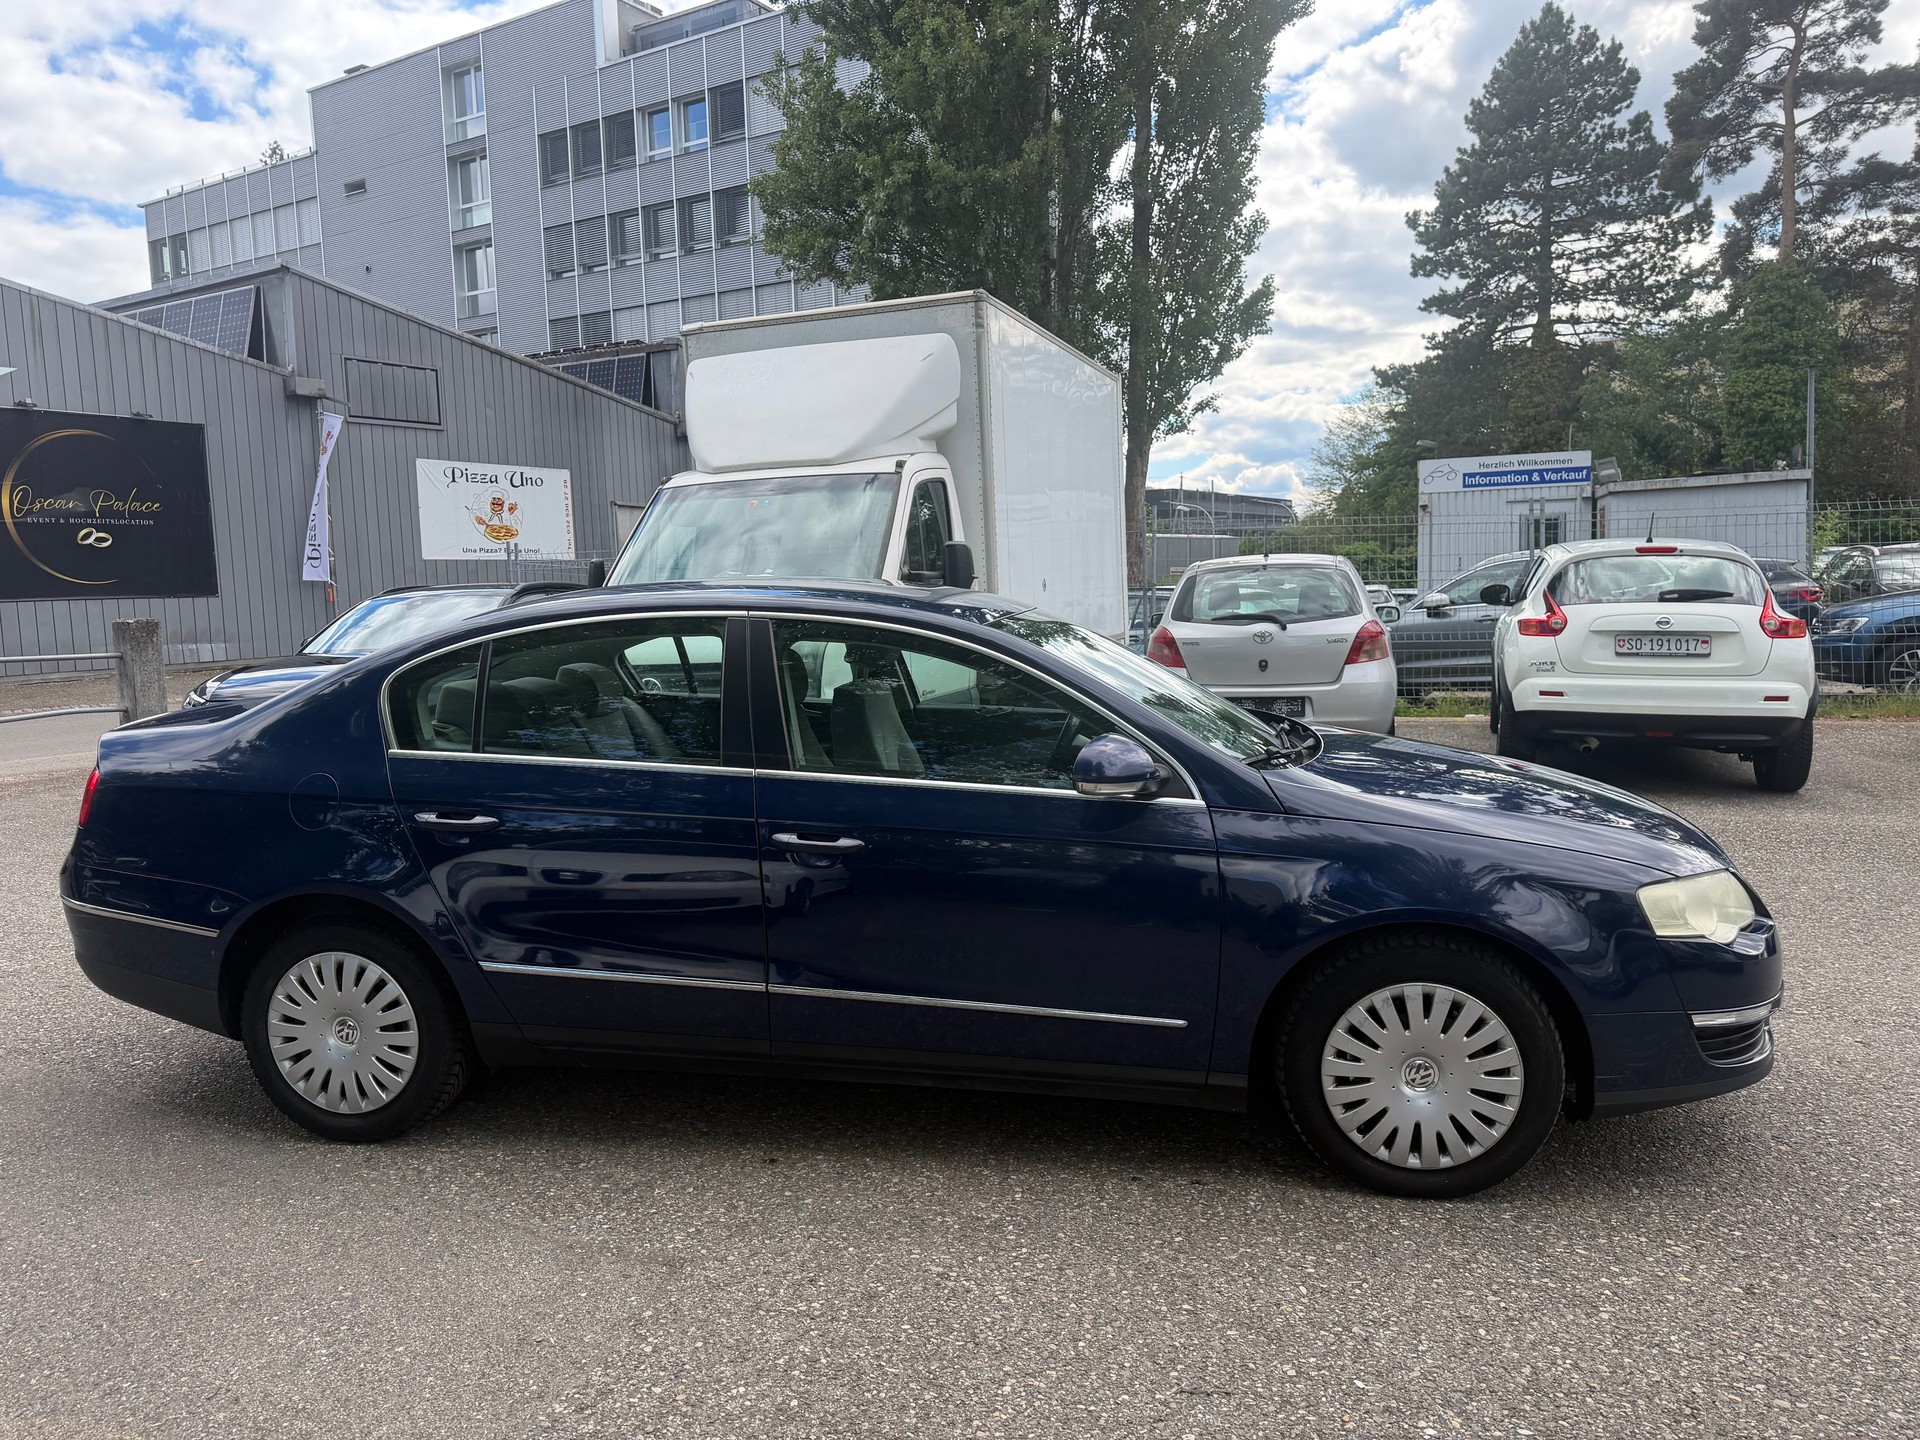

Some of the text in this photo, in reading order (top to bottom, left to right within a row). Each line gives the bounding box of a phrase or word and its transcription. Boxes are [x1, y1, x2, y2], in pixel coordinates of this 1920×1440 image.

[1478, 457, 1573, 469] Herzlich Willkommen
[443, 467, 544, 488] Pizza Uno
[1464, 470, 1588, 486] Information & Verkauf
[12, 485, 164, 518] Oscar Palace
[69, 517, 155, 525] HOCHZEITSLOCATION
[1528, 659, 1557, 667] JUKE
